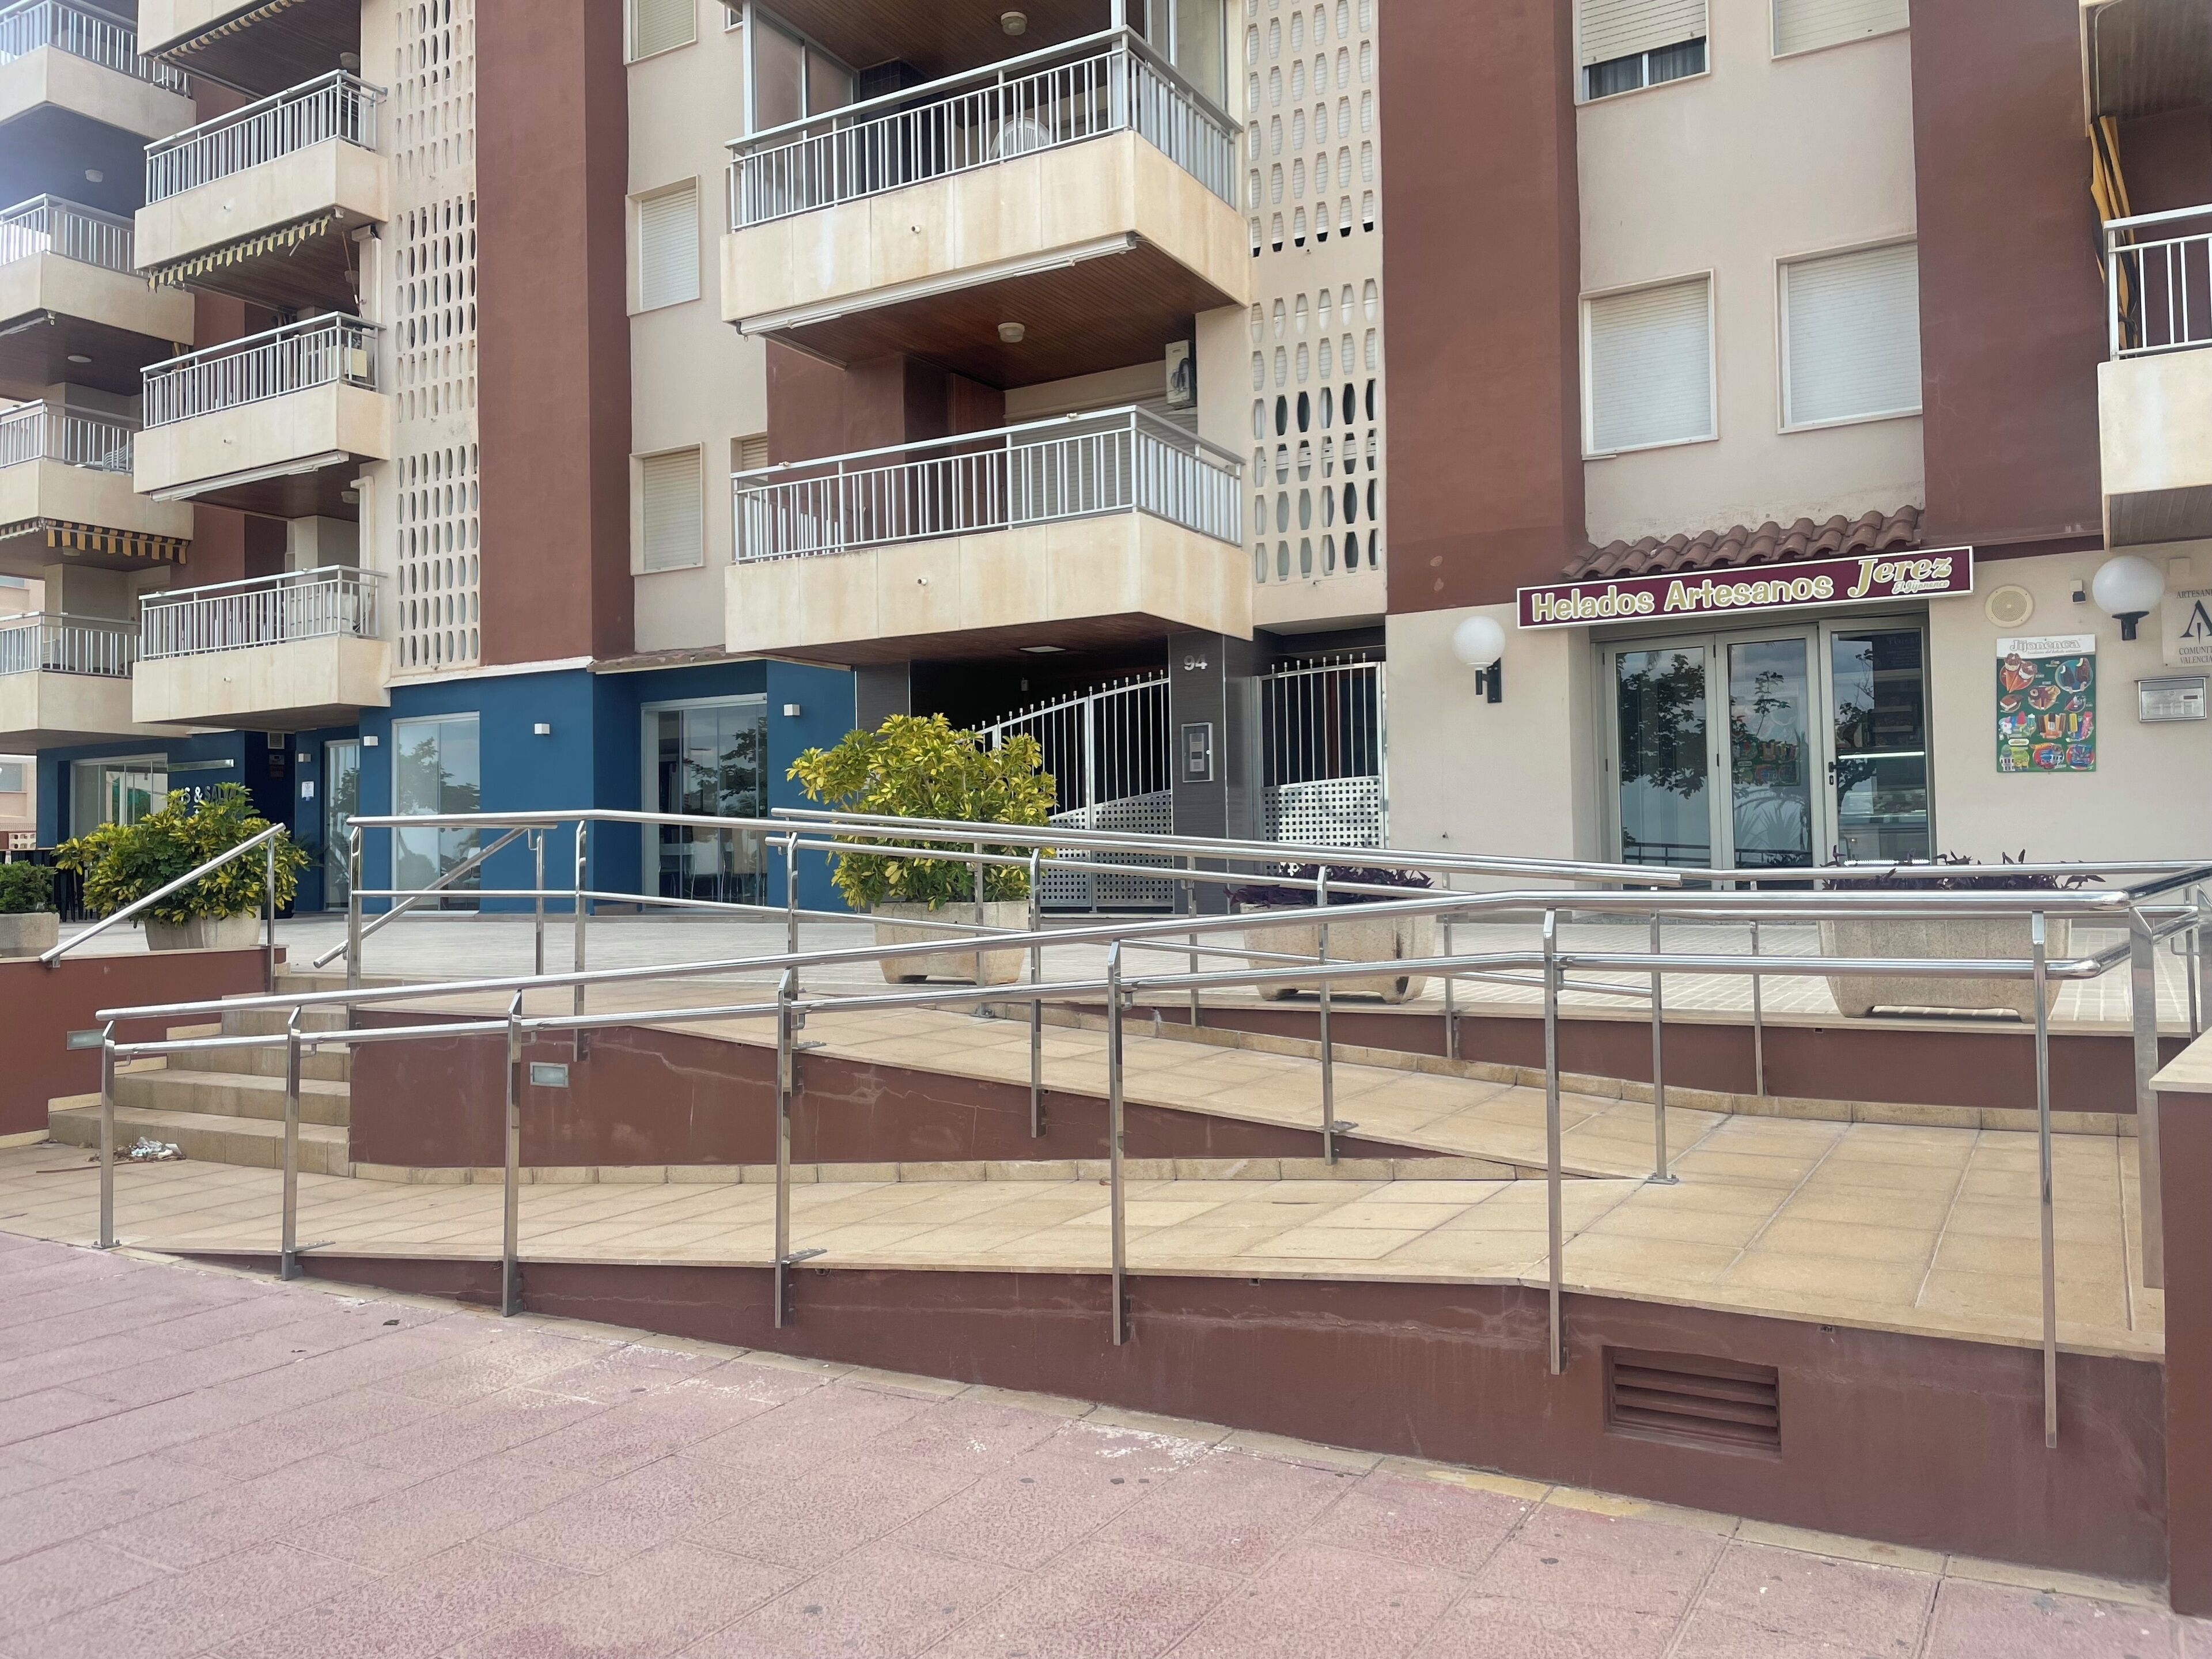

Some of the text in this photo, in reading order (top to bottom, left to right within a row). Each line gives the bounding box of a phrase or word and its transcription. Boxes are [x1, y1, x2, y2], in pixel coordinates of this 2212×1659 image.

[1532, 557, 1952, 622] Helados Artesanos Jerez
[1891, 581, 1905, 594] El
[2010, 639, 2081, 652] Jijonenca
[1184, 654, 1207, 671] 94
[194, 786, 203, 803] &
